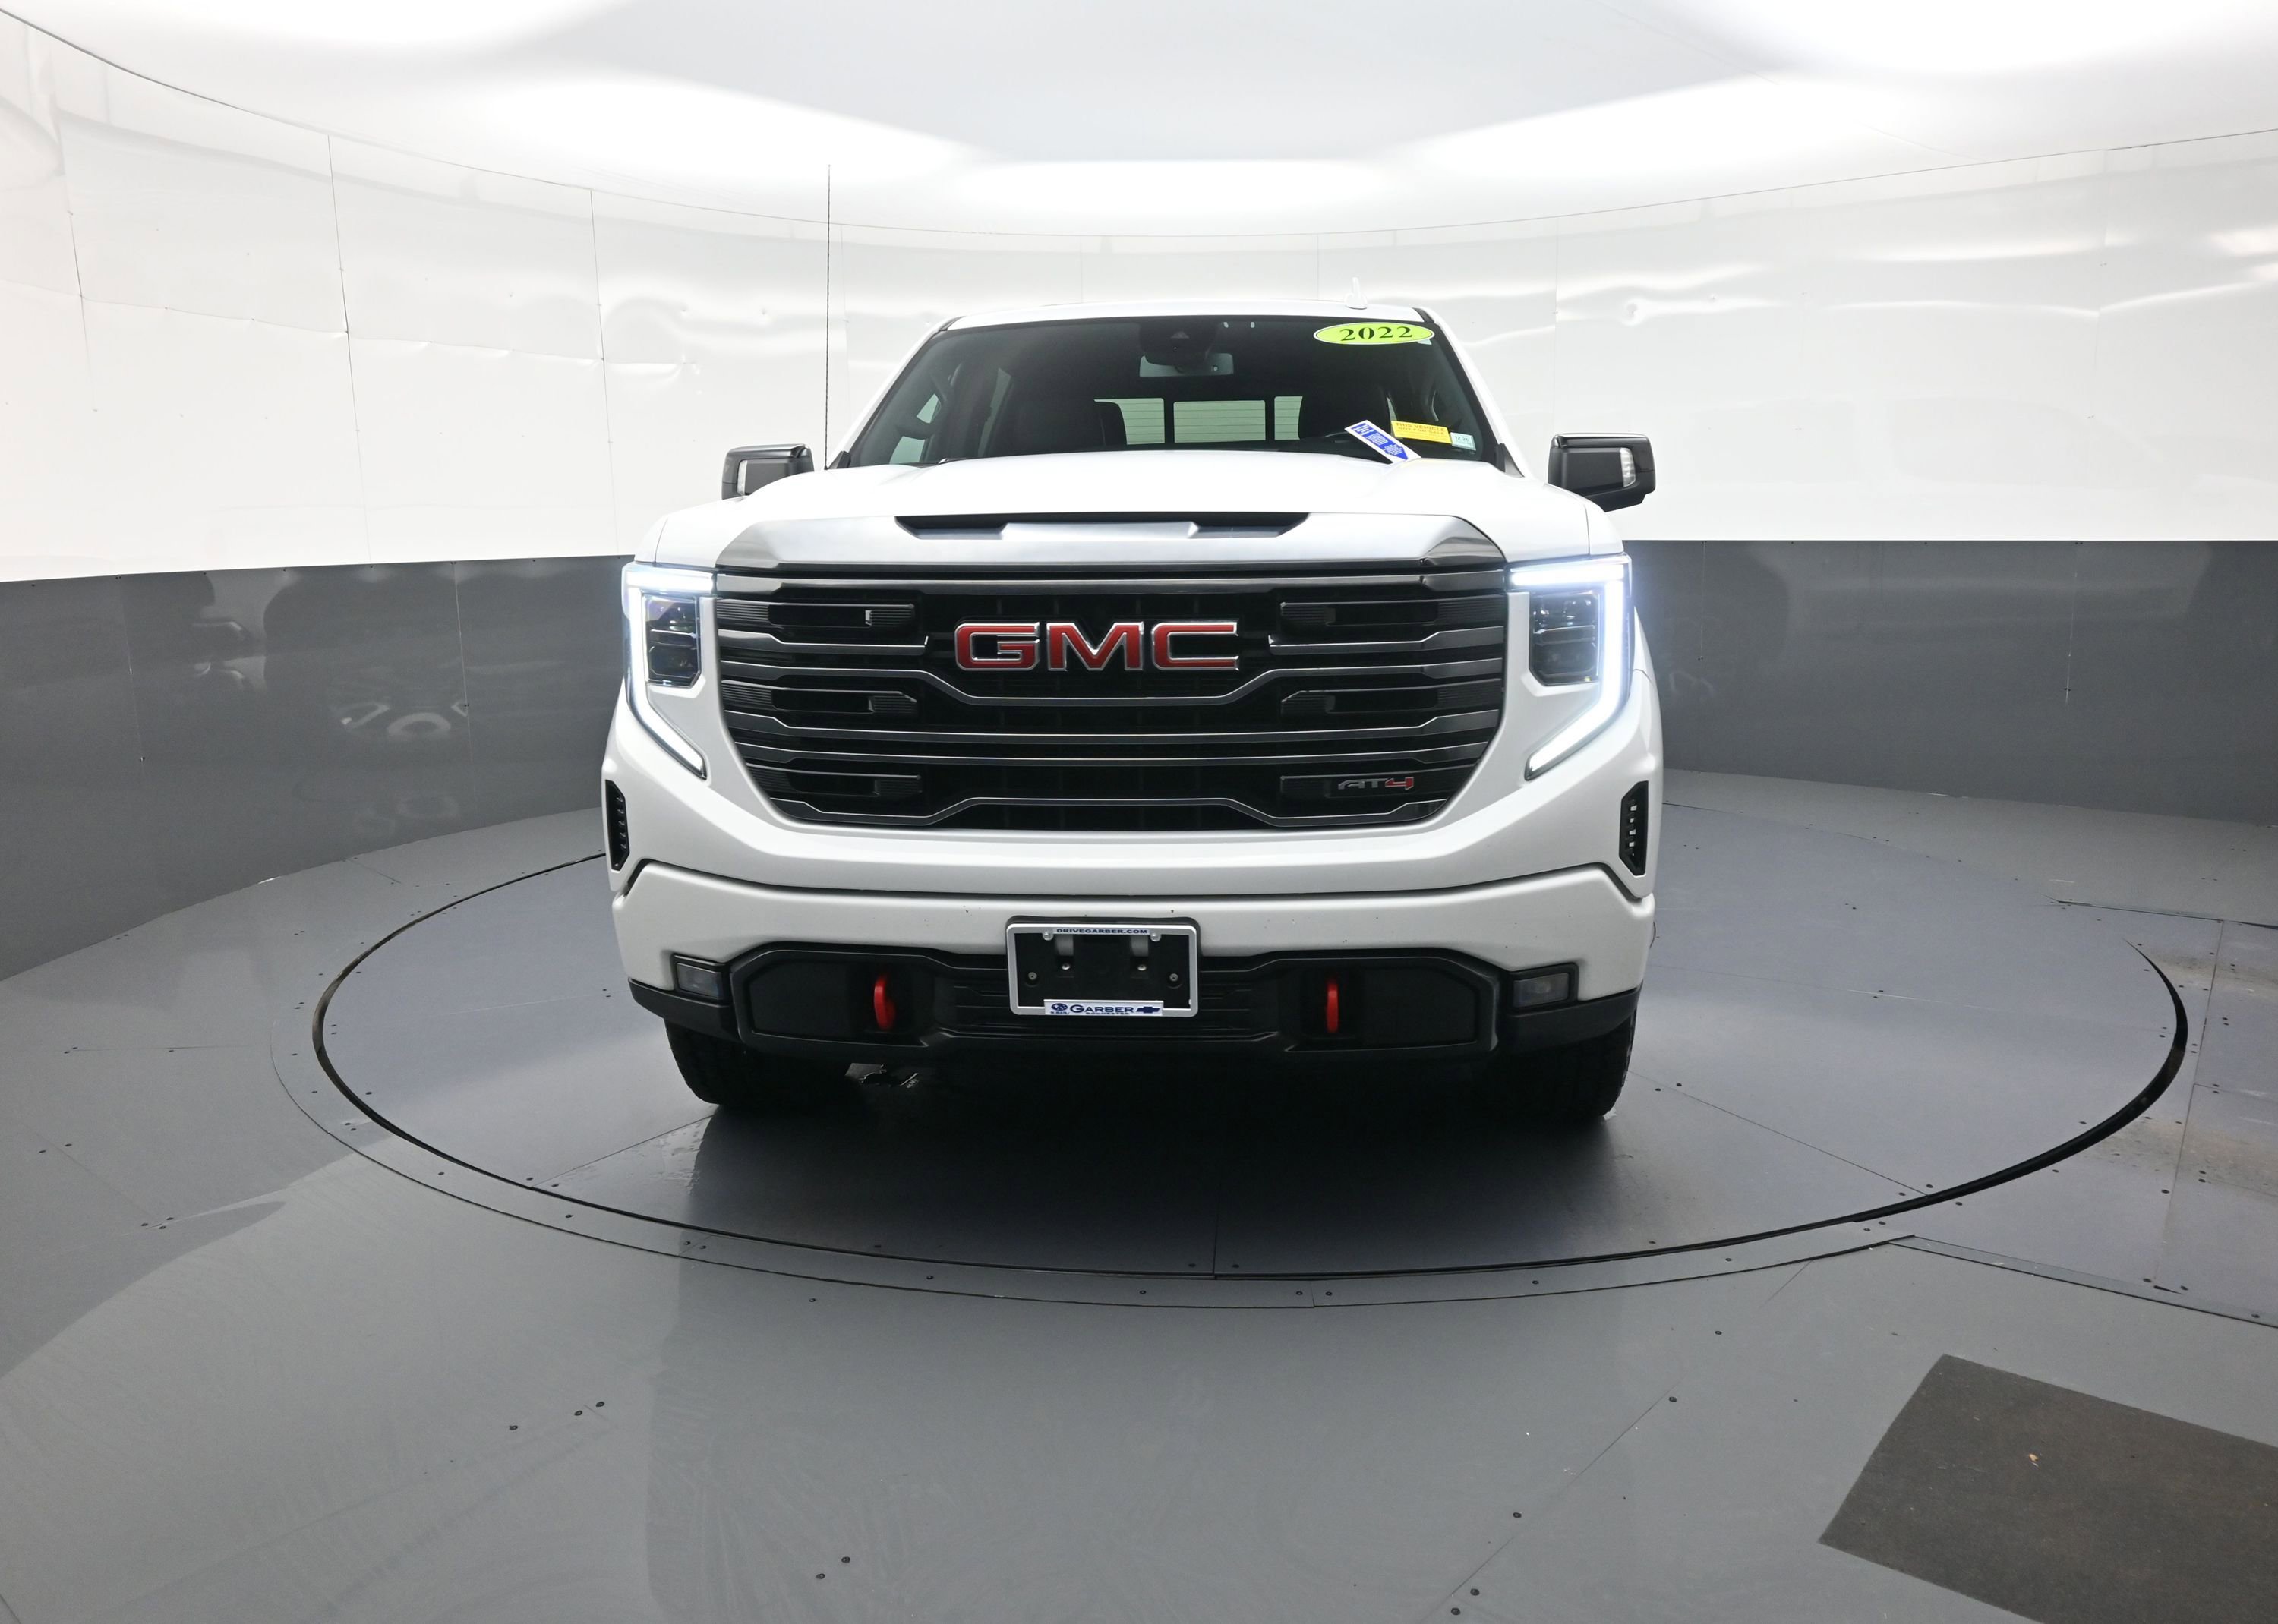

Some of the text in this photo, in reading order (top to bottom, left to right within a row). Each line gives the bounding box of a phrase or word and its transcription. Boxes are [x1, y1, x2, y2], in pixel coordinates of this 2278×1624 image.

[1339, 326, 1413, 342] 2022
[954, 621, 1239, 671] GMC
[1338, 776, 1415, 790] AT4
[1070, 1004, 1134, 1014] GARBER
